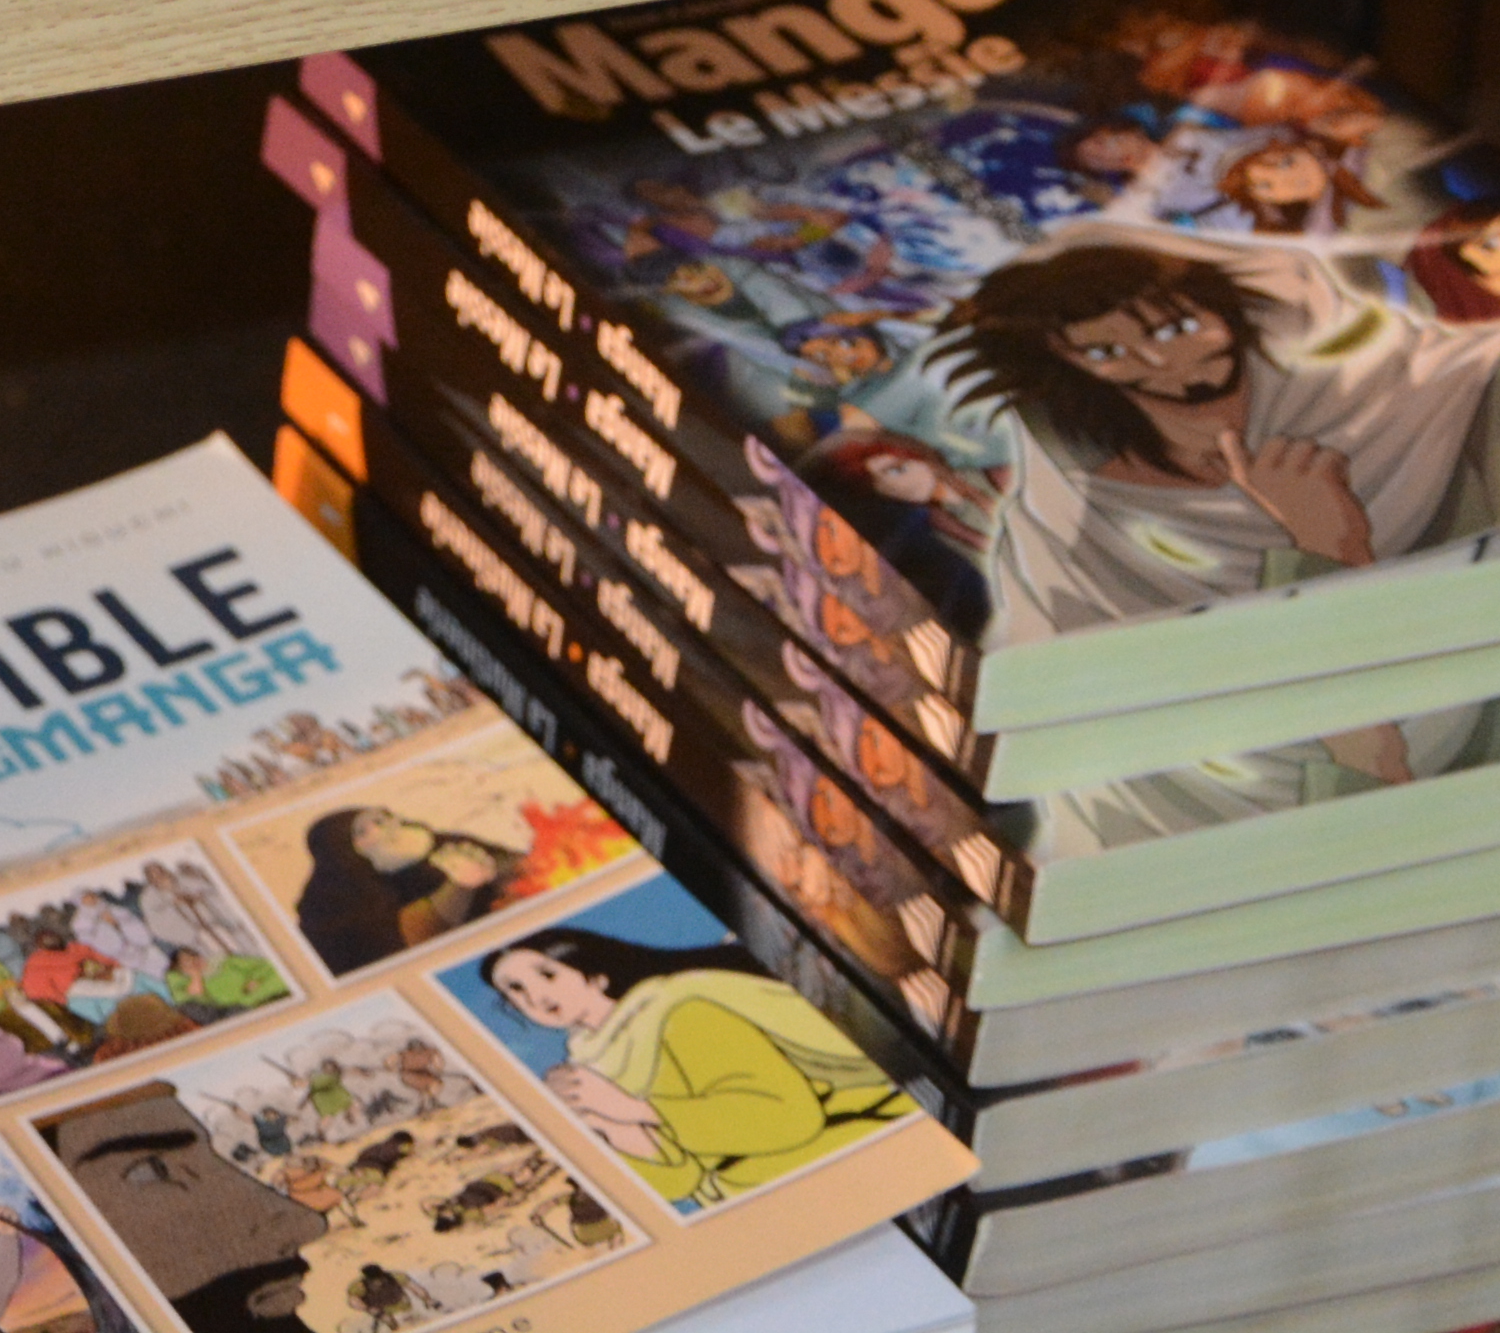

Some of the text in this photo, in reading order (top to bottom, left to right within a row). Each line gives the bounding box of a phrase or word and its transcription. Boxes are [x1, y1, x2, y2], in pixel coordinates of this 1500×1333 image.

[651, 35, 1028, 156] Le Messie
[597, 319, 681, 430] Manga
[585, 390, 676, 500] Manga
[626, 518, 715, 633] Manga
[597, 579, 680, 691] Manga
[587, 651, 674, 765] Manga
[582, 750, 667, 860] Manga
